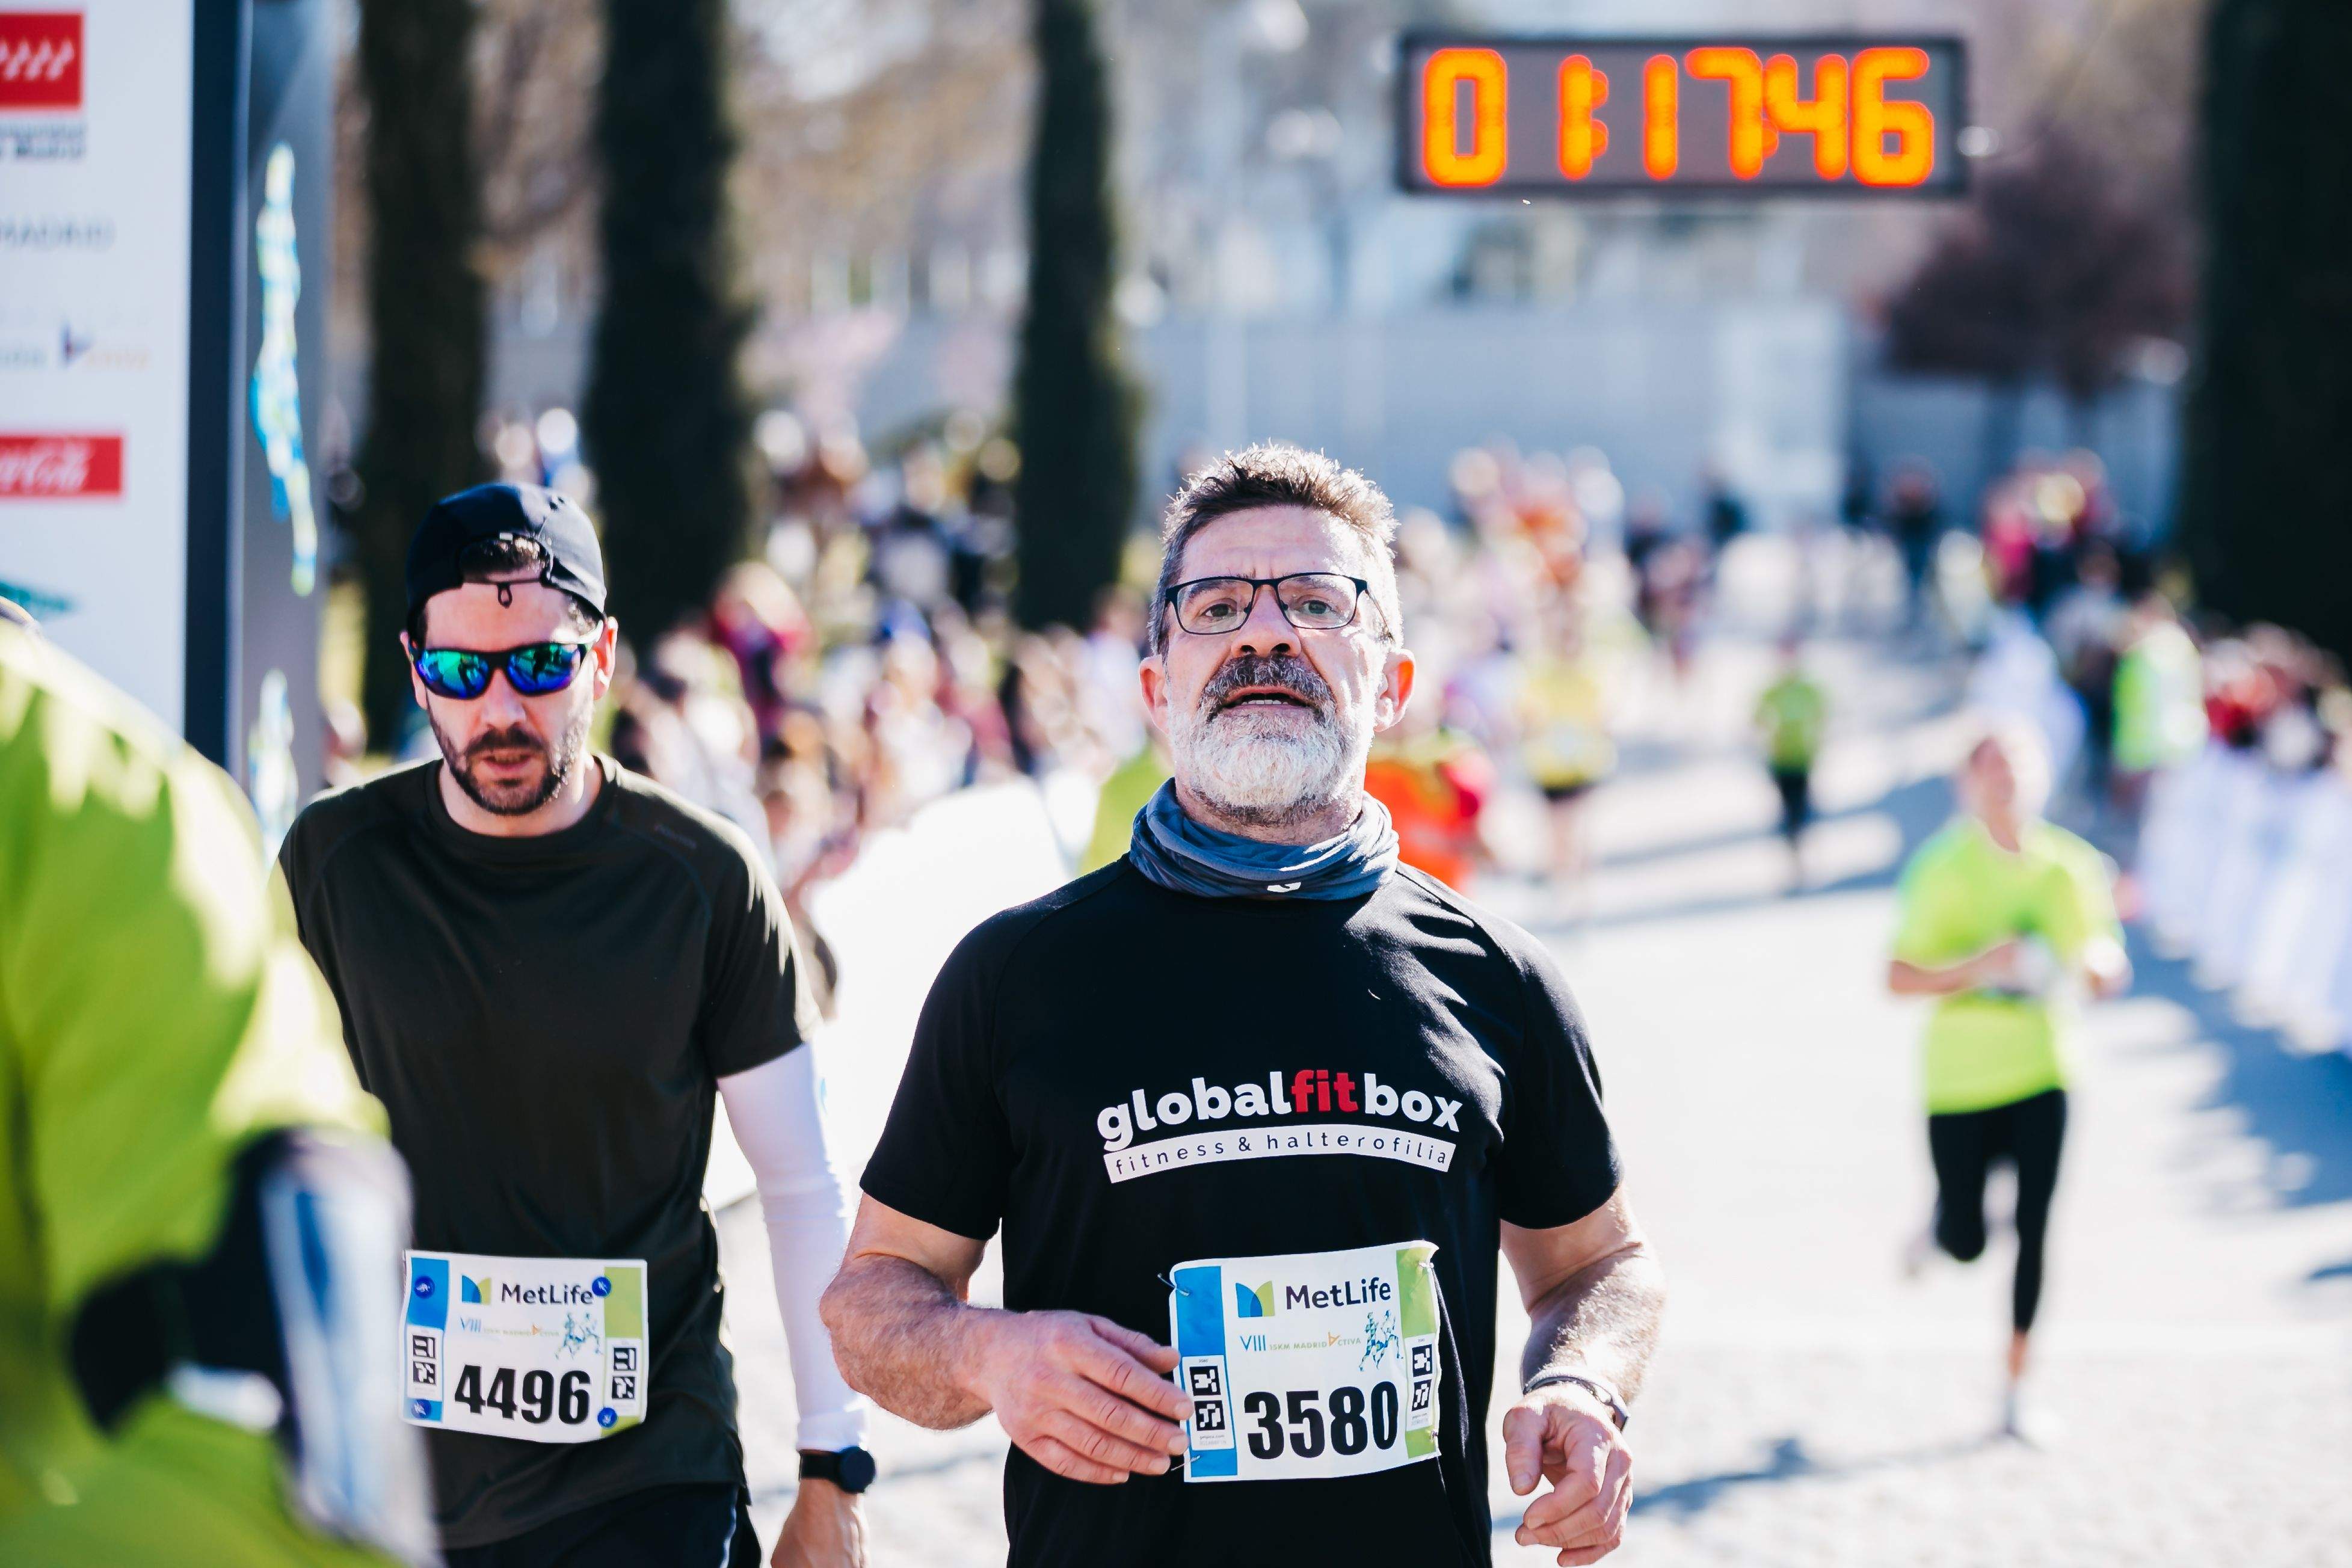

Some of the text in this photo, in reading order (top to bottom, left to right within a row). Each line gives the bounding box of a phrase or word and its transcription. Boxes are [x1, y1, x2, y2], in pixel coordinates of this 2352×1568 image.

[1115, 1132, 1446, 1175] fitness & halterofilia
[502, 1283, 594, 1305] MetLife
[1286, 1277, 1391, 1310] MetLife
[1240, 1335, 1266, 1351] VIII
[1293, 1341, 1327, 1350] MADRID
[455, 1365, 591, 1424] 4496
[1244, 1381, 1399, 1459] 3580
